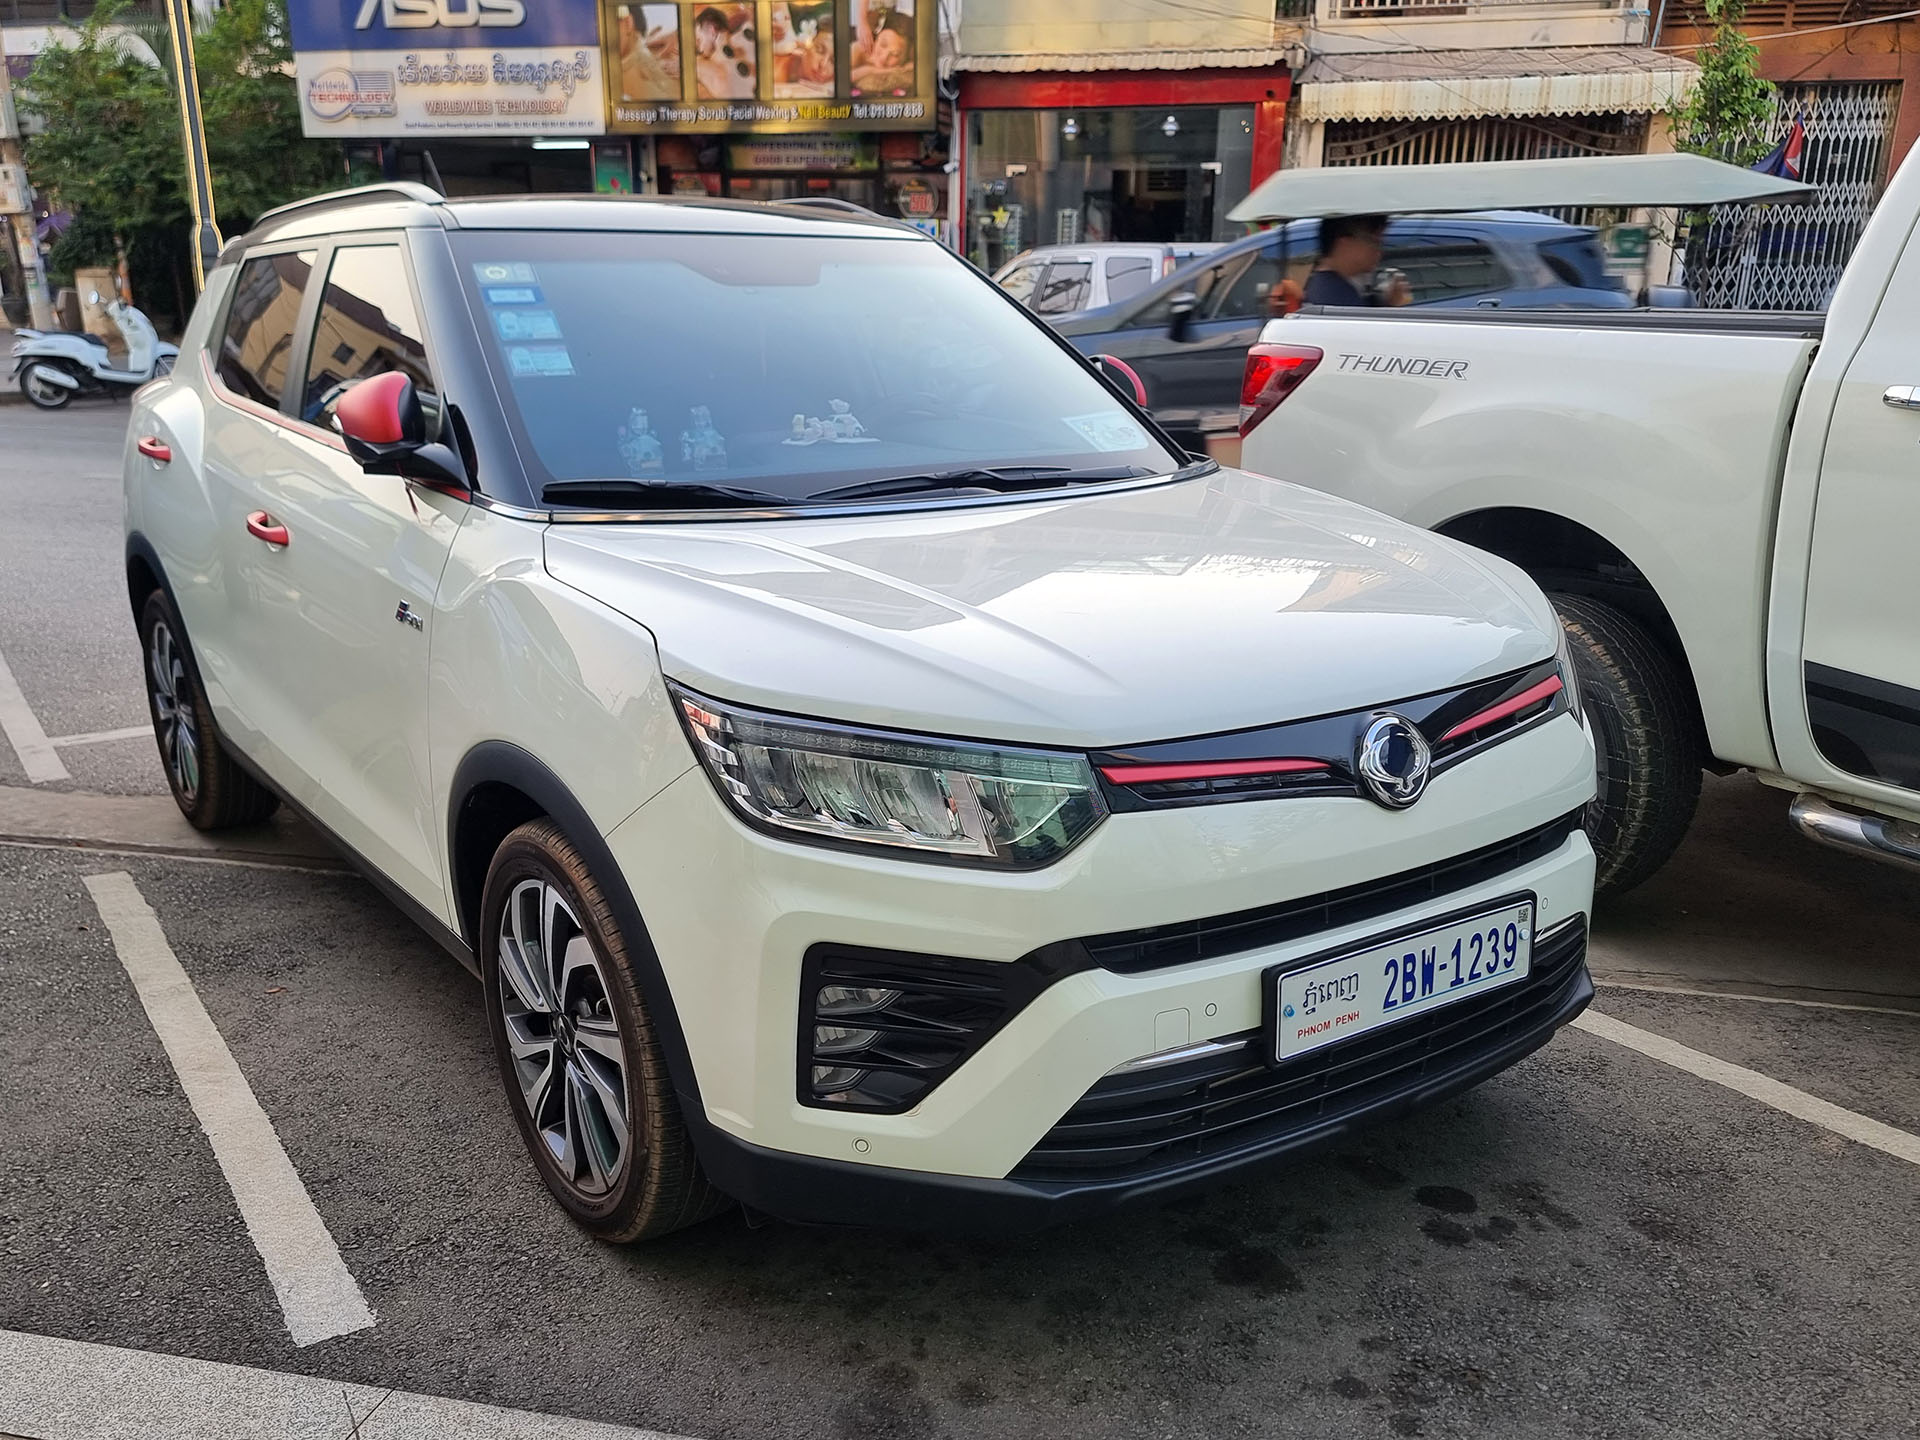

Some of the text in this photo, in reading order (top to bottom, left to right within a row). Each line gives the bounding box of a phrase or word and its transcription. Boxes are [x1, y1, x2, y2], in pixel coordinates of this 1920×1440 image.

[309, 91, 391, 103] TECHNOLOGY
[425, 99, 567, 114] WORLDWIDE TECHNOLOGY
[615, 106, 657, 124] Massage
[658, 105, 697, 123] Therapy
[698, 105, 726, 120] Scrub
[727, 105, 755, 120] Facial
[790, 105, 798, 119] &
[1338, 353, 1469, 379] THUNDER
[1383, 921, 1518, 1010] 2BW-1239
[1302, 972, 1359, 1015] ភ្នំពេញ
[1296, 1010, 1360, 1039] PHNOM PENH
